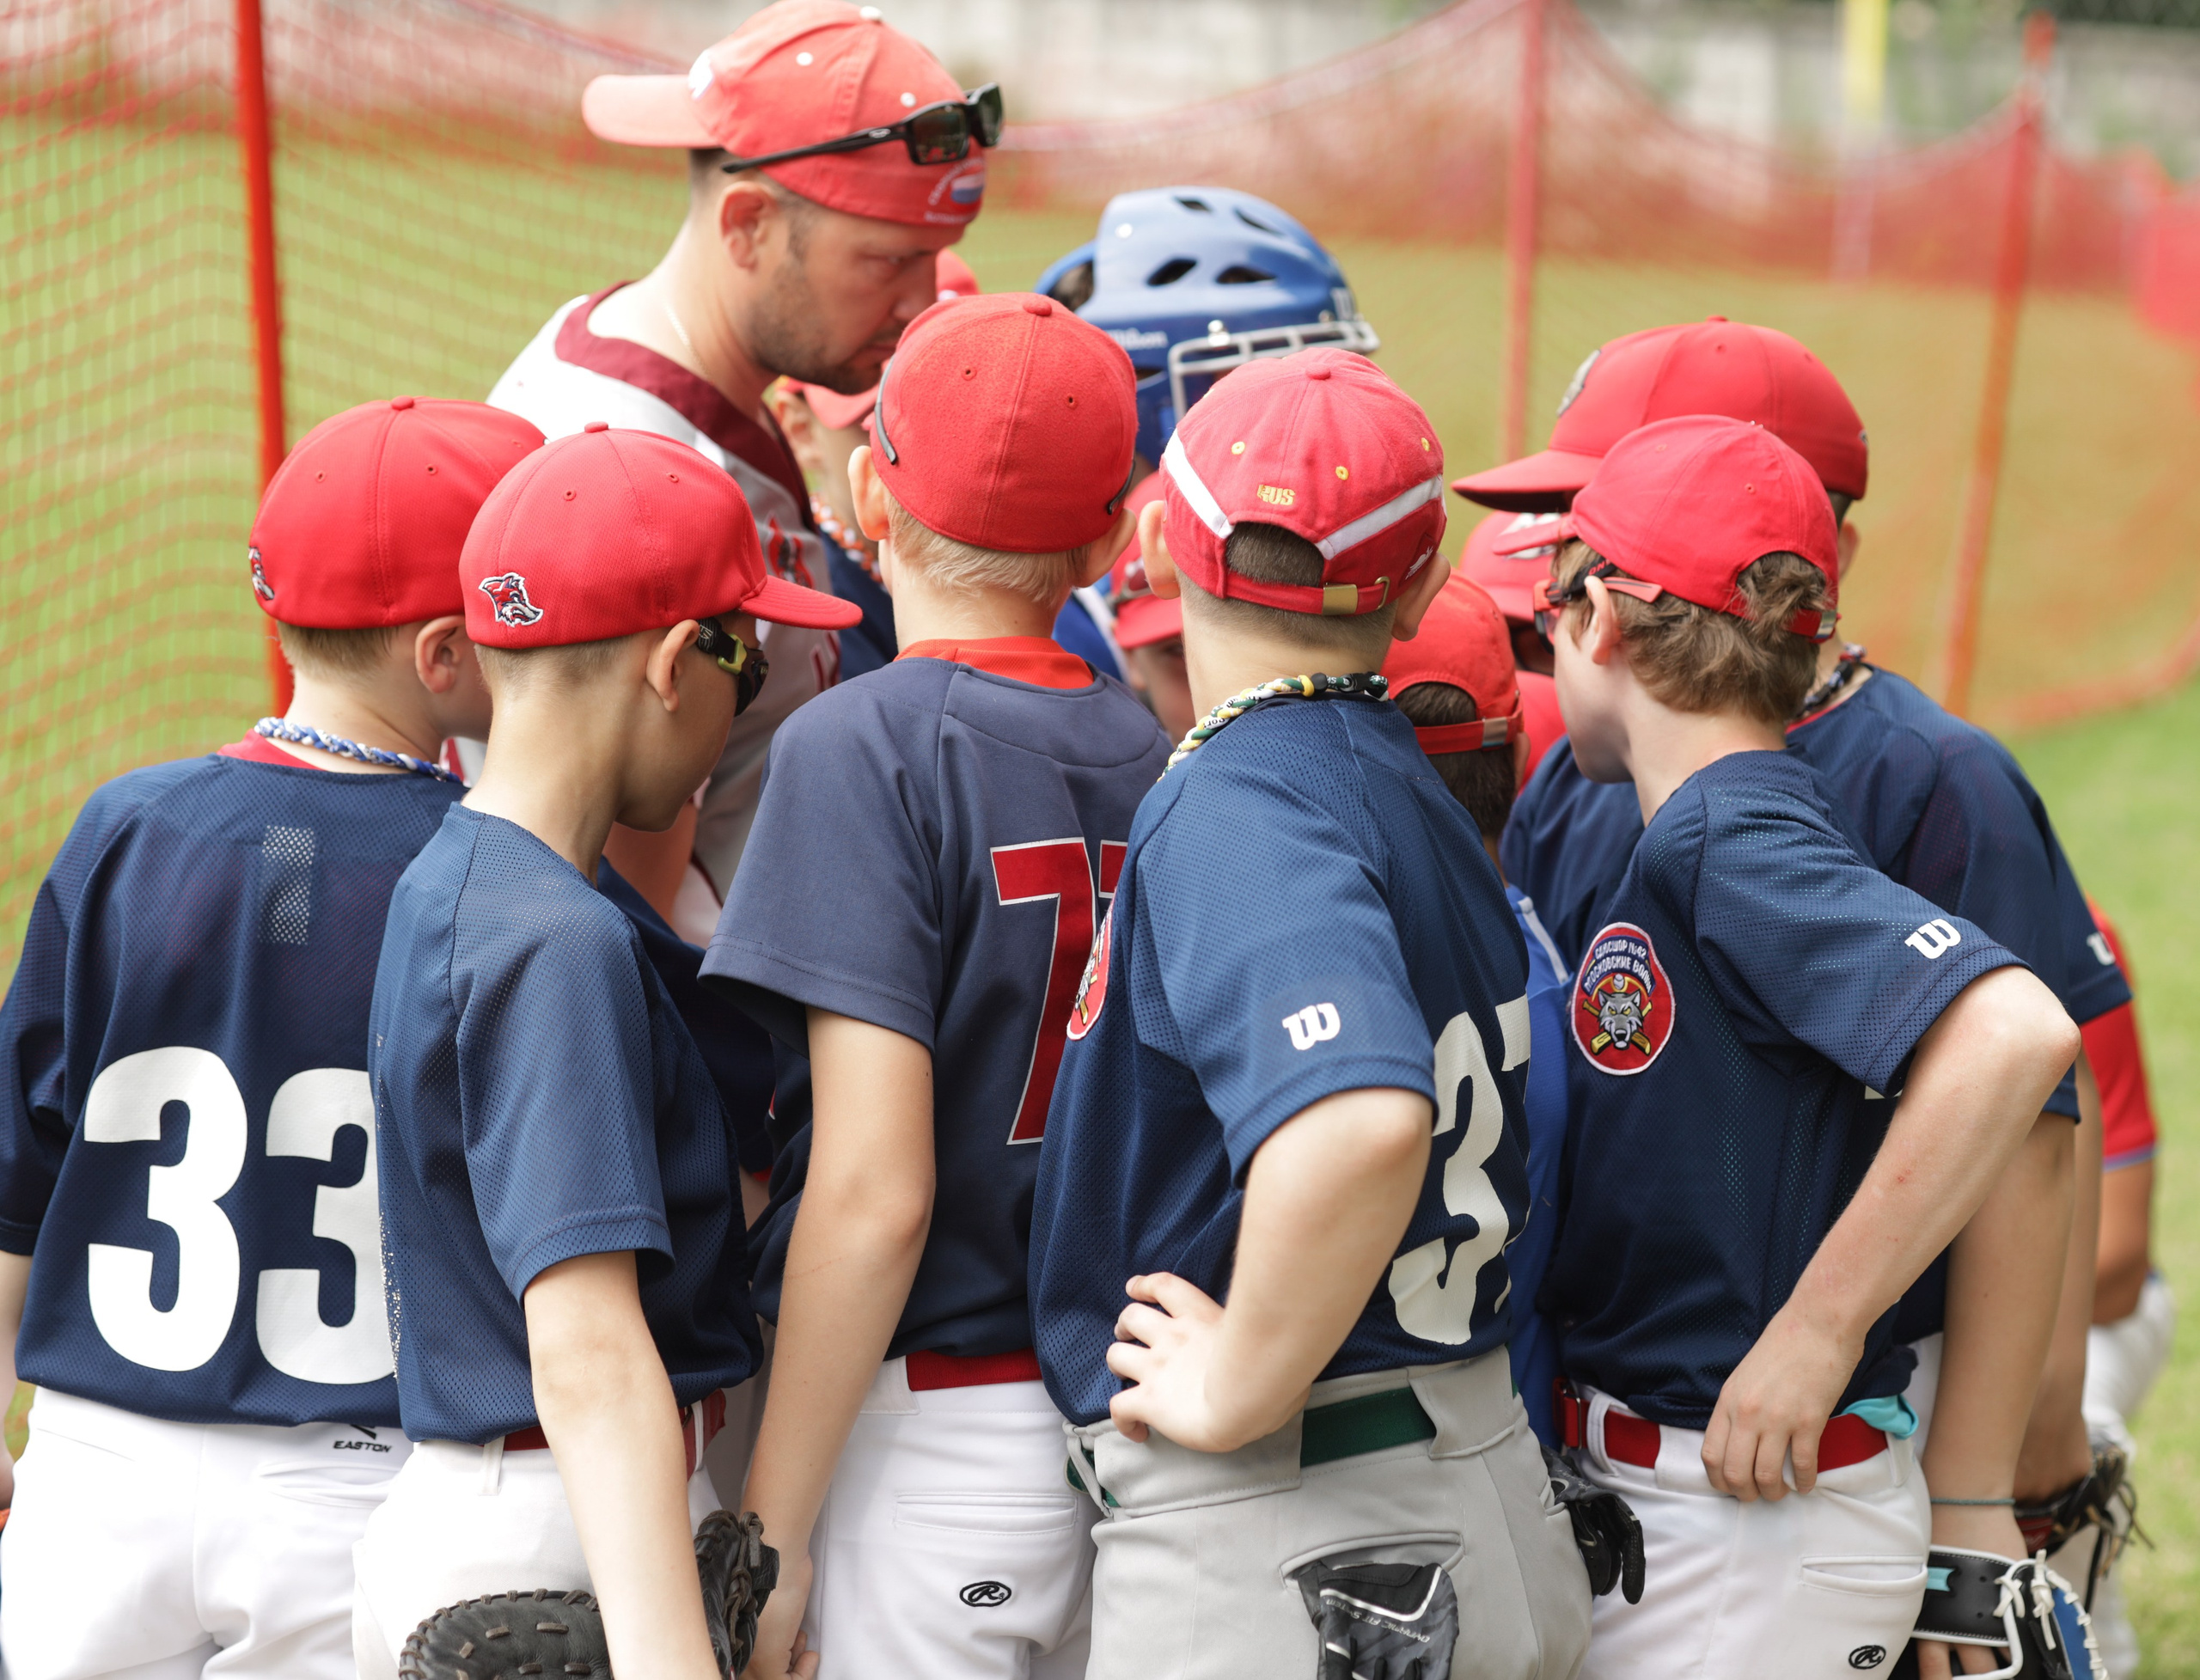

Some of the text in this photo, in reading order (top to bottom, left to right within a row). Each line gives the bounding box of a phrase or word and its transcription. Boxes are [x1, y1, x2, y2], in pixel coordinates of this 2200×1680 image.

[1256, 484, 1296, 505] RUS
[1584, 956, 1632, 993] МОСКОВСКИЕ
[84, 1046, 399, 1384] 33
[333, 1440, 393, 1453] EASTON
[1362, 1615, 1381, 1627] FIT
